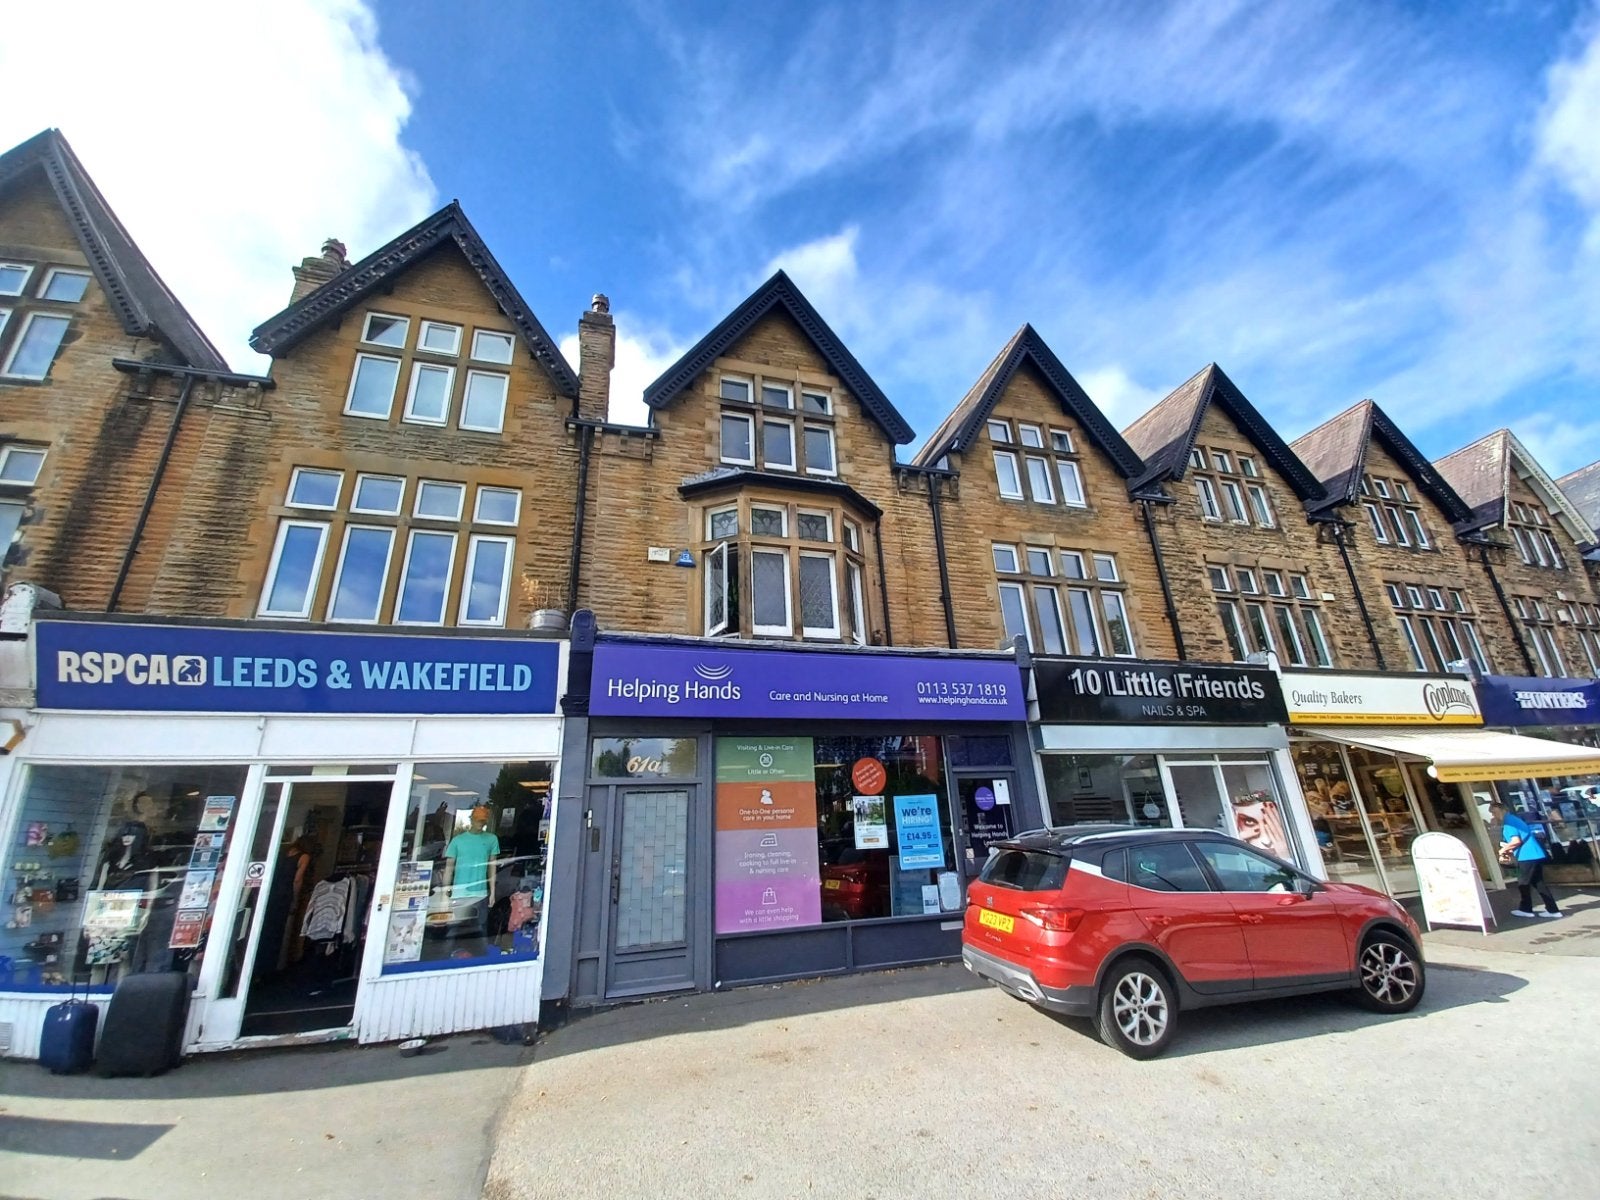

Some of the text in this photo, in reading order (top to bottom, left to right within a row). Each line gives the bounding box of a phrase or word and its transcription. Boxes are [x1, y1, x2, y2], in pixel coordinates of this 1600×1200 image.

[57, 650, 170, 685] RSPCA
[213, 656, 532, 691] LEEDS & WAKEFIELD
[608, 678, 741, 704] Helping Hands
[917, 682, 1006, 696] 0113 537 1819
[1070, 669, 1265, 699] 10 Little Friends
[769, 690, 888, 704] Care and Nursing at Home
[918, 696, 1008, 706] www.helpinghands.co.uk
[1292, 690, 1363, 707] Quality Bakers
[1515, 691, 1587, 709] HUNTERS
[1142, 705, 1207, 716] NAILS & SPA
[626, 755, 662, 773] 61a
[902, 806, 932, 817] we're
